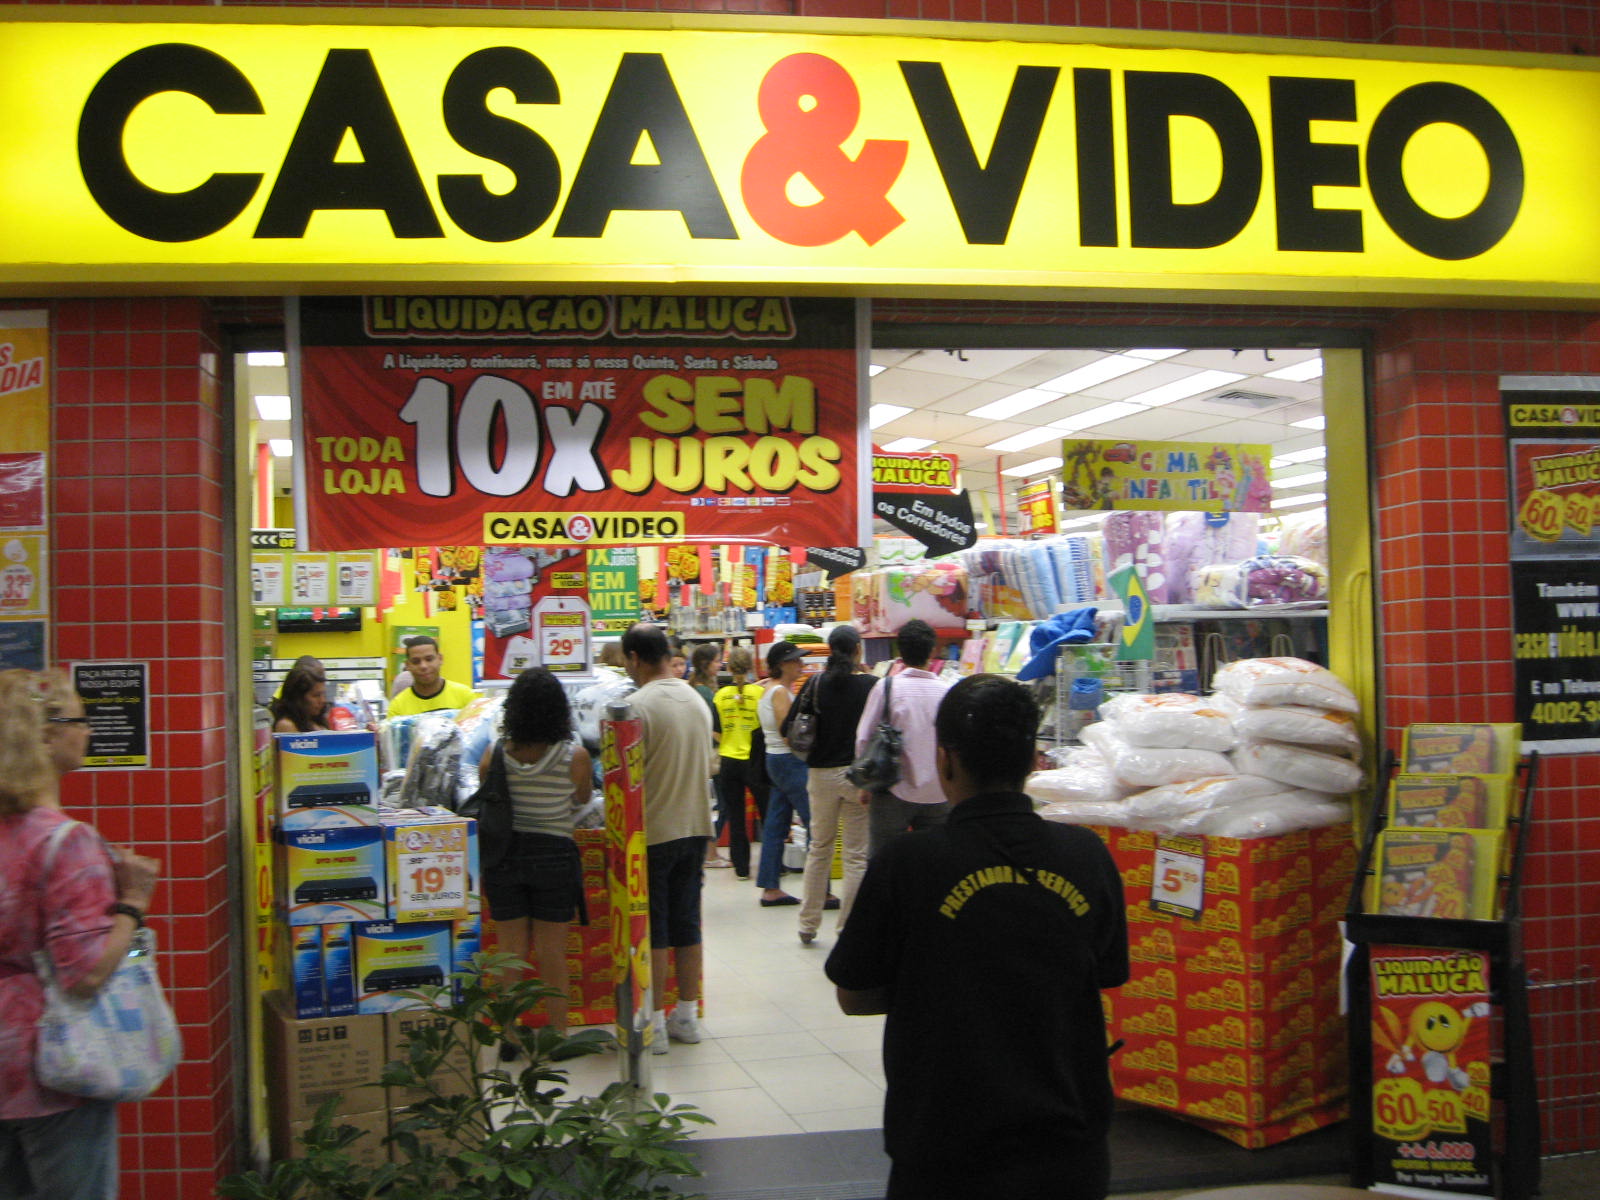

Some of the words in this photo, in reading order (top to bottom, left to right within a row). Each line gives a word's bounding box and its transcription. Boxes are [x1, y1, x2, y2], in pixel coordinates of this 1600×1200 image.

[77, 42, 1525, 260] CASA&VIDEO
[620, 297, 787, 332] MALUCA
[384, 354, 395, 369] A
[399, 354, 467, 372] Liquidação
[546, 357, 573, 369] mas
[594, 357, 629, 369] nessa
[684, 355, 718, 369] Sexta
[722, 358, 730, 369] e
[733, 354, 779, 370] Sábado
[542, 382, 573, 399] EM
[579, 377, 617, 399] ATÉ
[639, 374, 817, 435] SEM
[316, 436, 405, 463] TODA
[611, 435, 842, 494] JUROS
[323, 468, 407, 495] LOJA
[489, 513, 679, 543] CASA&VIDEO
[877, 502, 895, 515] os
[897, 507, 967, 546] Corredores
[912, 500, 934, 518] Em
[936, 510, 972, 535] todos
[1531, 700, 1600, 725] 4002-3
[289, 738, 318, 749] vicini
[296, 833, 326, 844] vicini
[1161, 867, 1182, 892] 5
[365, 923, 395, 934] vicini
[1378, 972, 1486, 995] MALUCA
